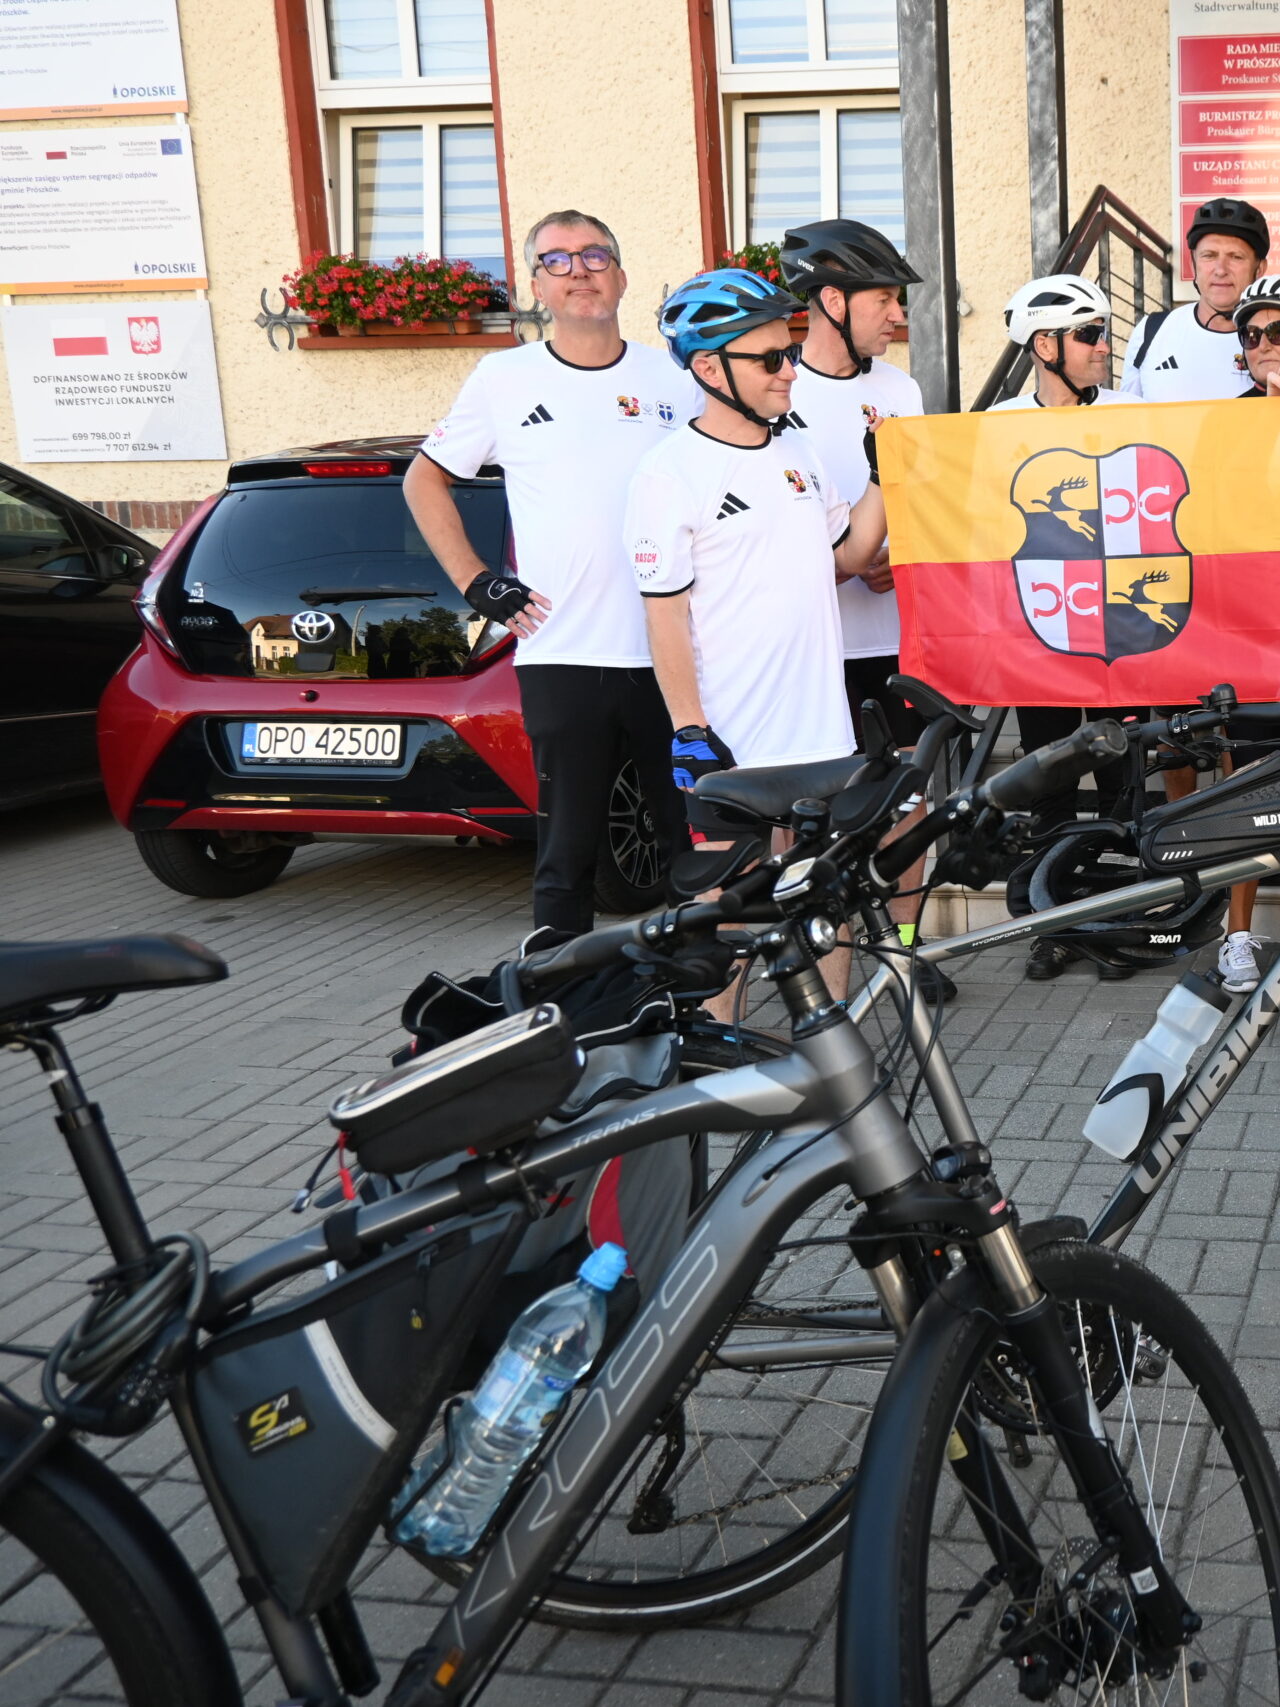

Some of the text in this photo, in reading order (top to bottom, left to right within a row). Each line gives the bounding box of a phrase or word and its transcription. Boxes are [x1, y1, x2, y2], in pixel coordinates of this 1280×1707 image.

[1194, 0, 1278, 13] Stadtverwaltung
[1227, 44, 1258, 55] RADA
[1224, 59, 1235, 69] W
[1221, 74, 1269, 85] Proskauer
[120, 85, 177, 98] OPOLSKIE
[1199, 110, 1263, 122] BURMISTRZ
[1207, 126, 1255, 137] Proskauer
[1193, 161, 1232, 173] URZĄD
[1234, 160, 1269, 171] STANU
[1212, 175, 1266, 185] Standesamt
[1269, 175, 1279, 184] in
[142, 263, 197, 274] OPOLSKIE
[797, 258, 815, 273] uvex
[33, 371, 188, 383] DOFINANSOWANO ZE ŚRODKÓW
[55, 384, 171, 396] RZĄDOWEGO FUNDUSZU
[55, 396, 175, 406] INWESTYCJI LOKALNYCH
[72, 432, 89, 441] 699
[123, 431, 131, 440] zł
[106, 443, 111, 452] 7
[113, 443, 129, 452] 707
[163, 443, 171, 451] zł
[257, 726, 396, 756] OPO 42500
[244, 743, 254, 752] PL
[1252, 814, 1278, 827] WILD
[972, 926, 1033, 947] HYDROFORMING
[1149, 934, 1182, 944] uvex
[572, 1107, 657, 1148] TRANS
[454, 1220, 720, 1650] KROSS
